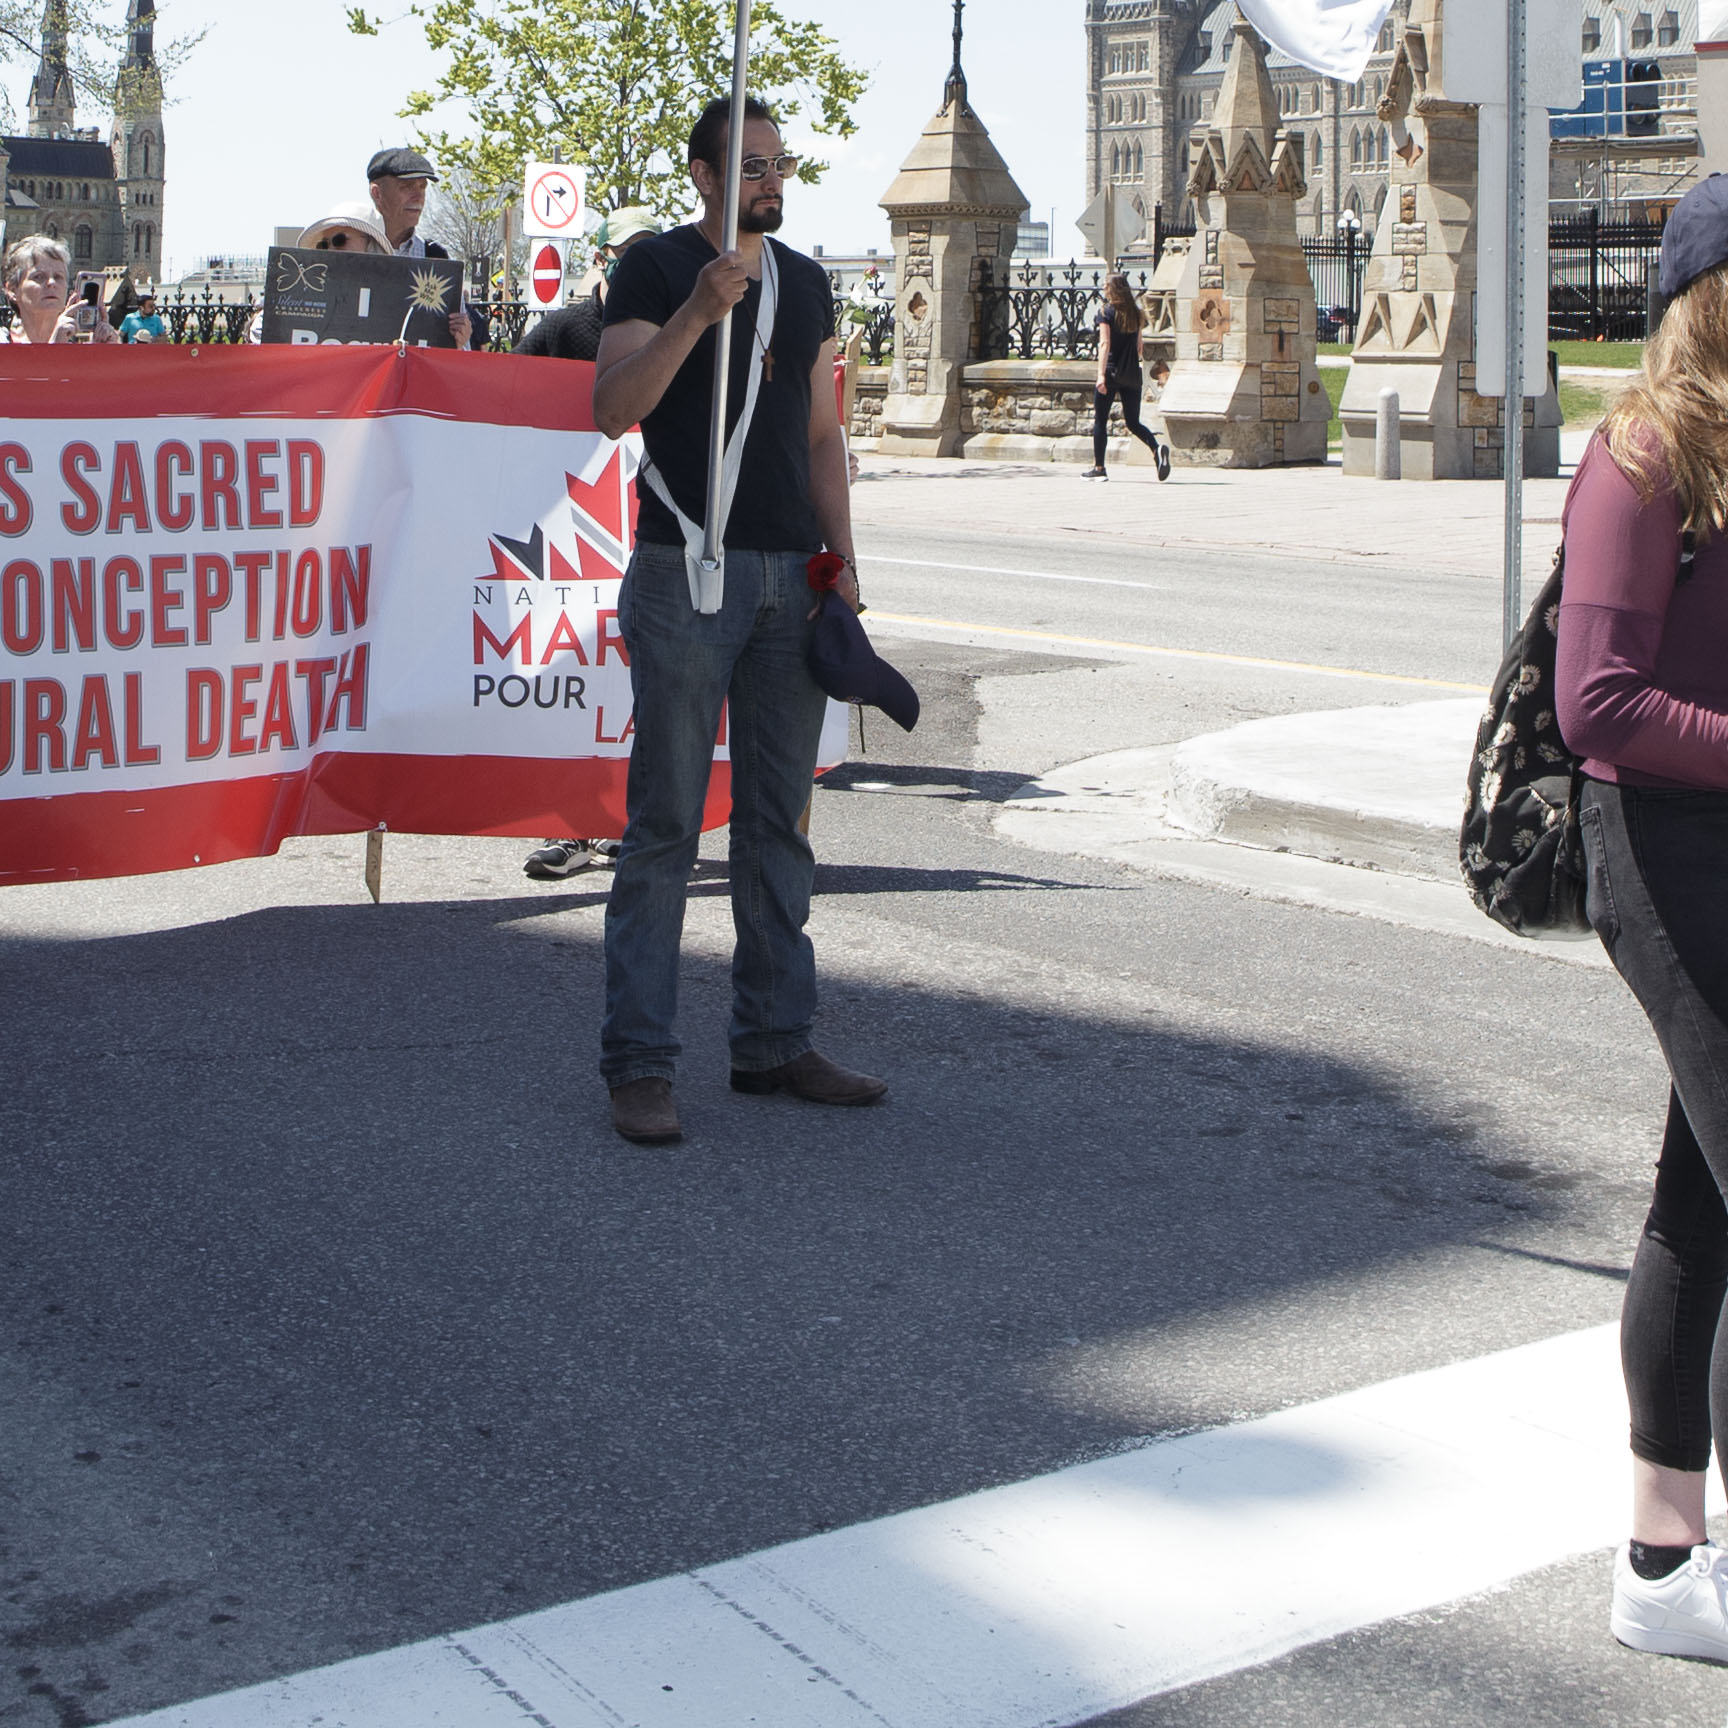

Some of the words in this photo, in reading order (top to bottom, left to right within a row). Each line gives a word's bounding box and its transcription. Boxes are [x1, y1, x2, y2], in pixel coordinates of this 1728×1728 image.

[59, 438, 326, 536] SACRED
[473, 585, 602, 605] NATI
[473, 609, 630, 667] MAR
[184, 641, 371, 762] DEATH
[474, 674, 587, 709] POUR
